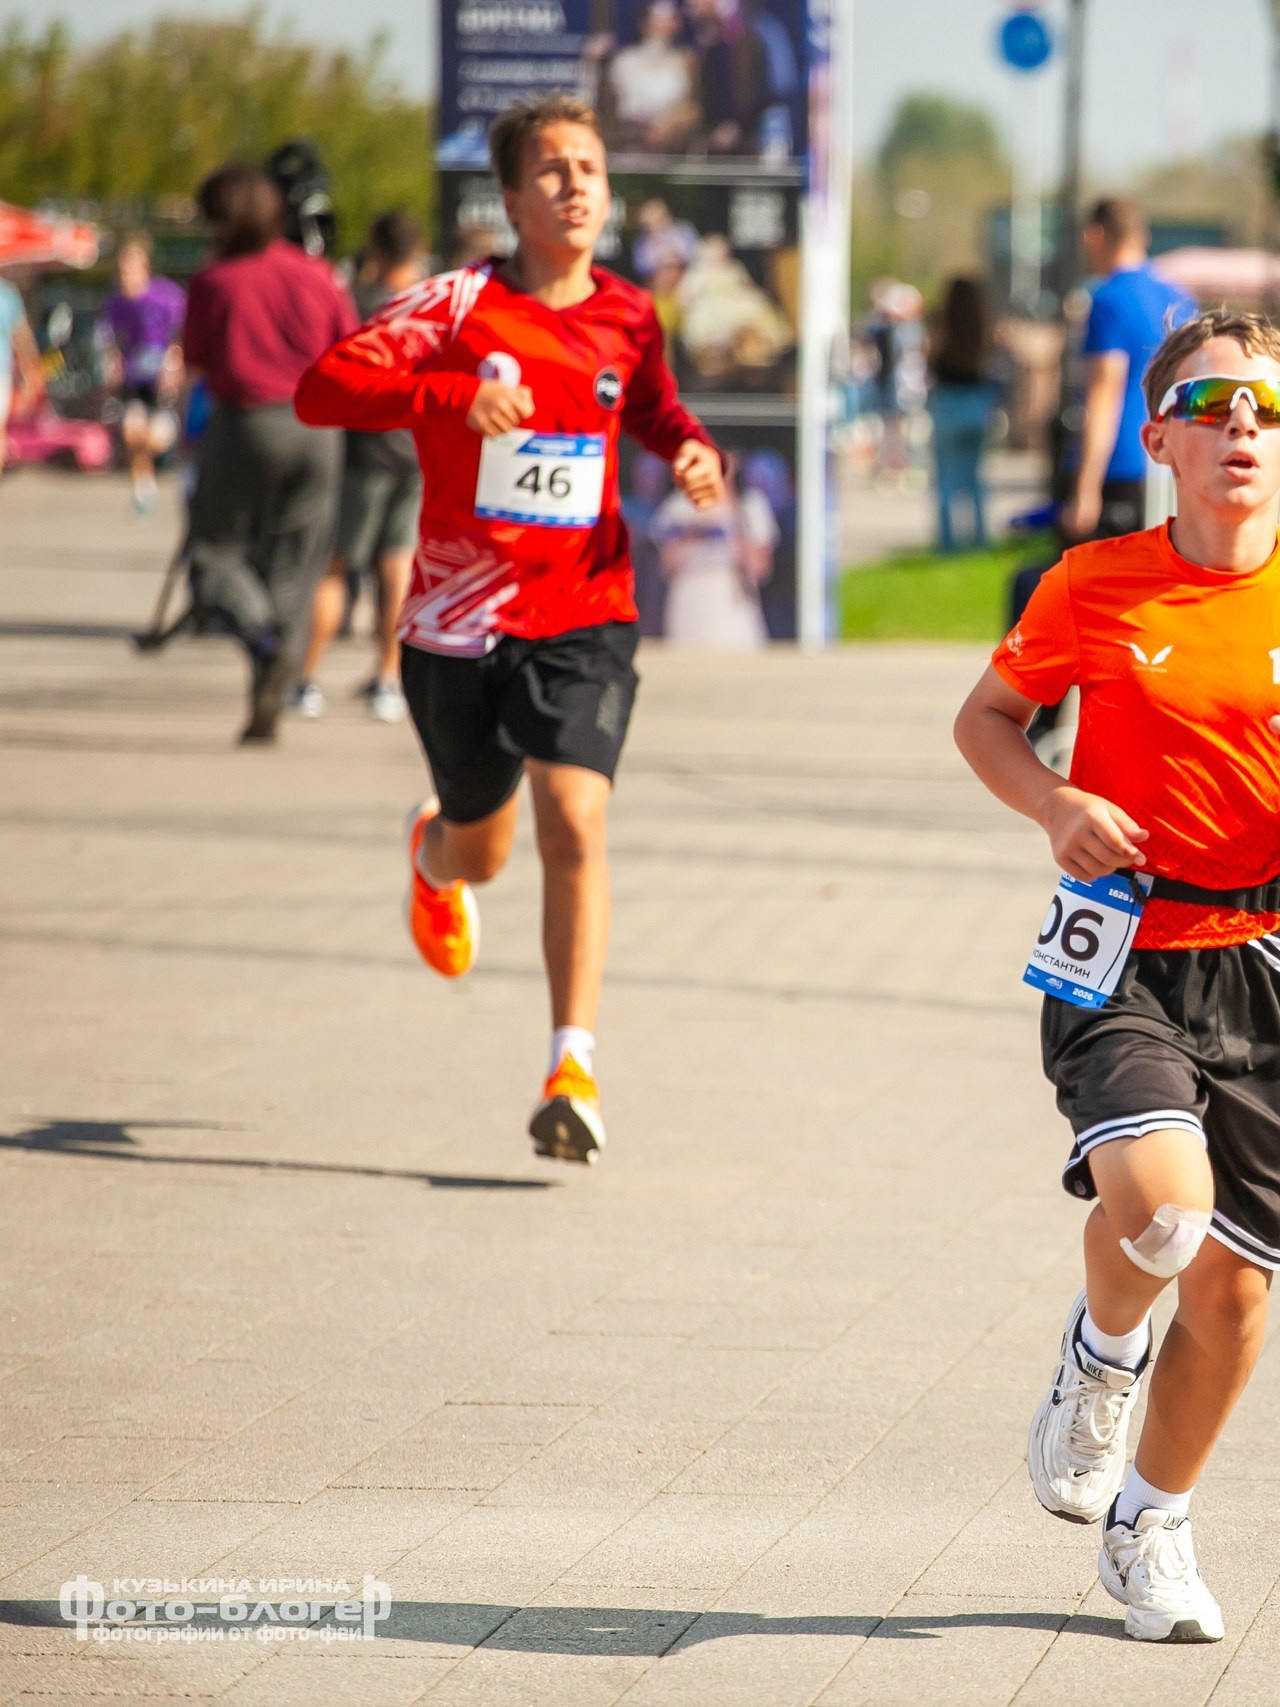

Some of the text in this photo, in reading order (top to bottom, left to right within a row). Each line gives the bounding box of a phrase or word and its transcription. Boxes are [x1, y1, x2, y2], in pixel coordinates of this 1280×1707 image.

[515, 464, 572, 498] 46
[1032, 949, 1091, 979] ОНСТАНТИН
[1086, 1361, 1103, 1379] NIKE
